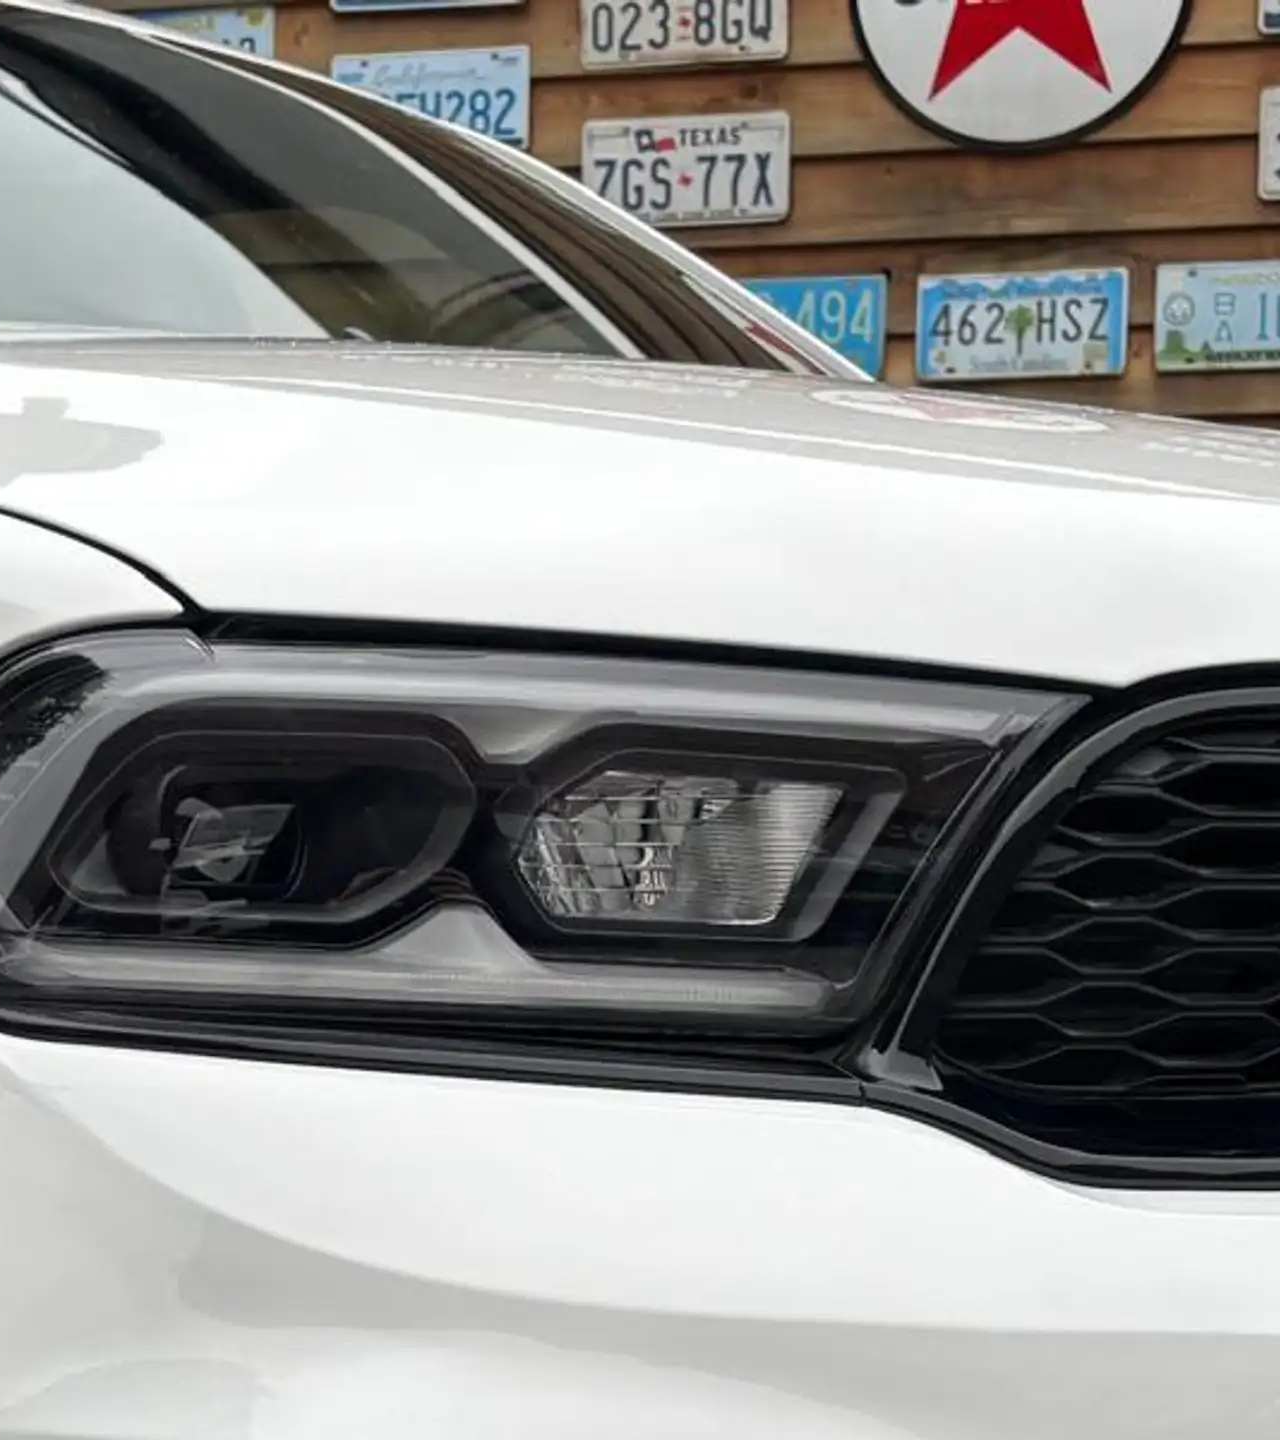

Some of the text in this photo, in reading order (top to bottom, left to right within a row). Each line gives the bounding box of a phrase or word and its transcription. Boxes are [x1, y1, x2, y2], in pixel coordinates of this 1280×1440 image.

[677, 126, 743, 148] TEXAS
[696, 151, 774, 207] 77X
[929, 298, 1111, 346] 462 HSZ
